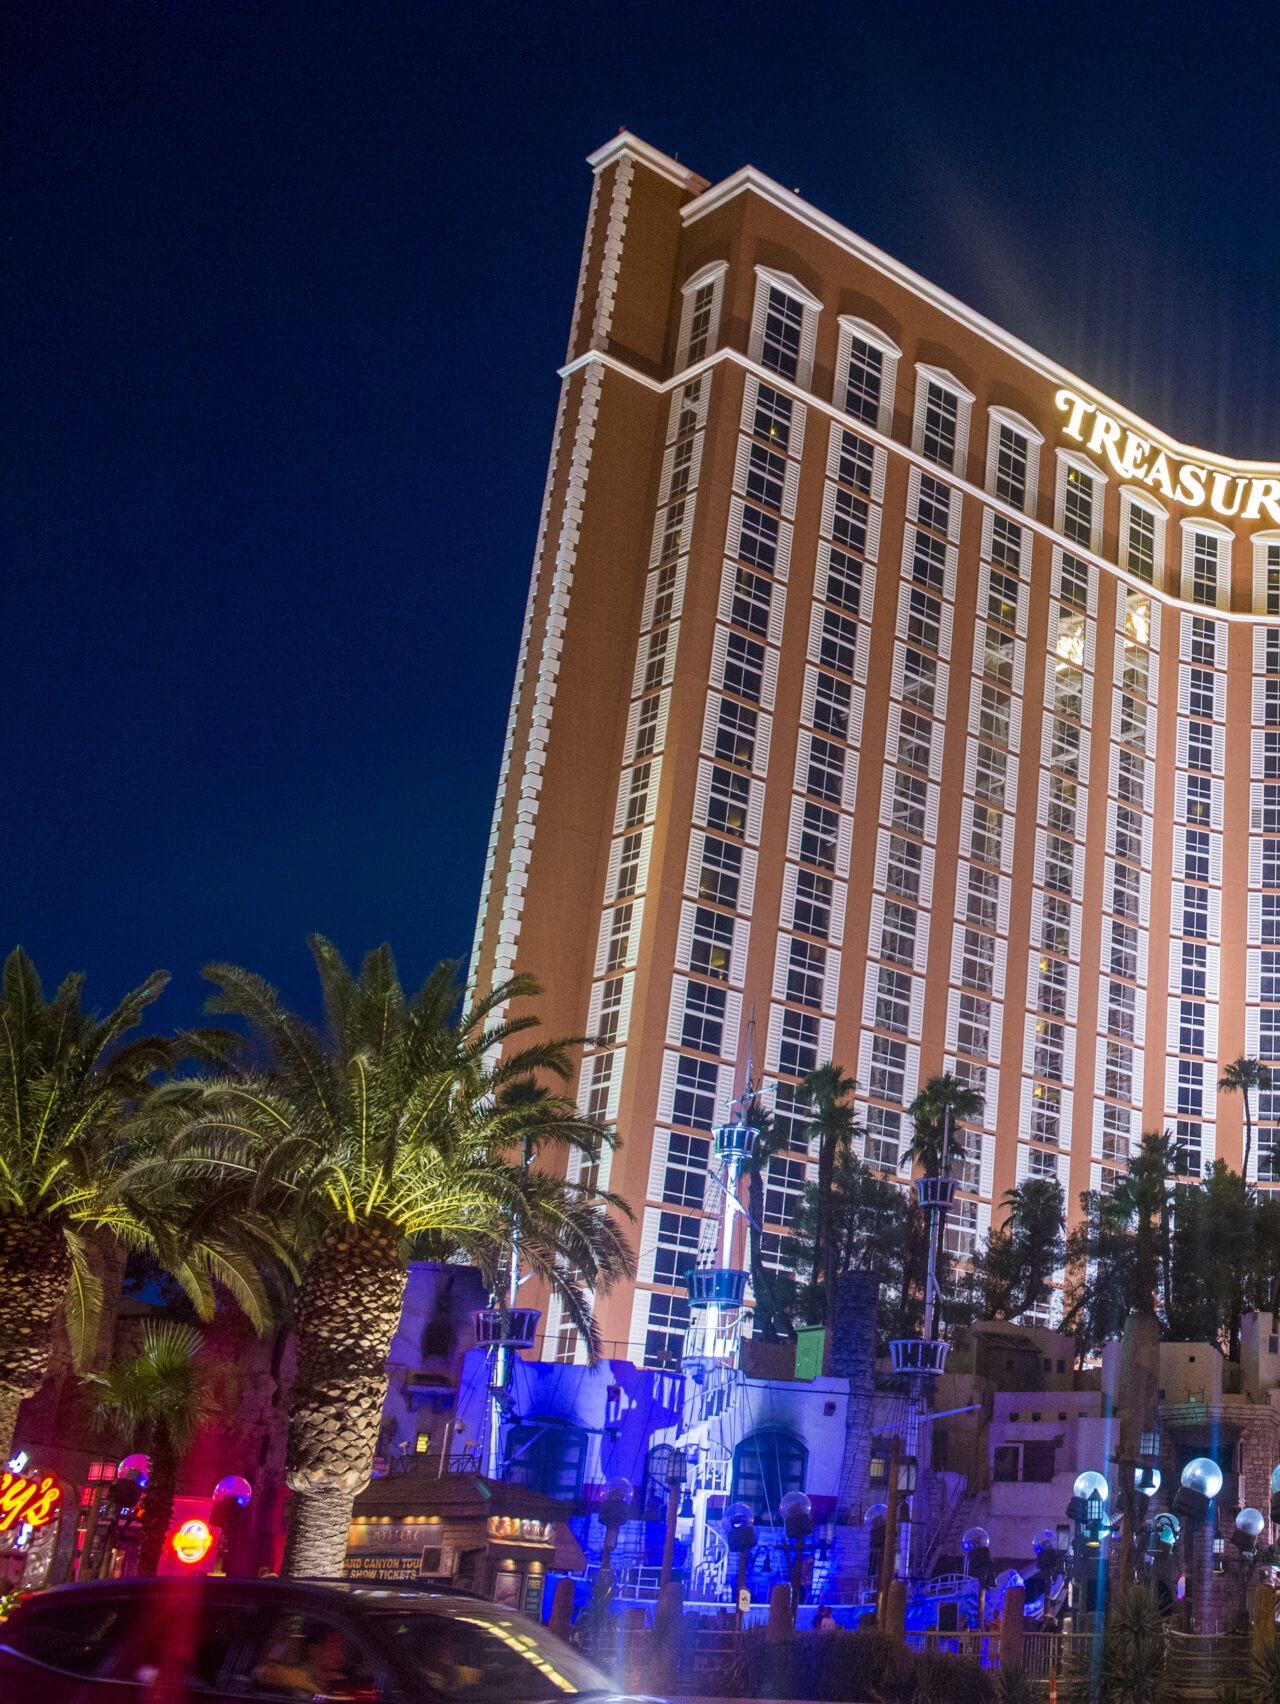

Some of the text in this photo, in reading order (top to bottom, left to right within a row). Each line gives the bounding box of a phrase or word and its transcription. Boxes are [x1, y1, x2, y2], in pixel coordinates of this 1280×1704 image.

[343, 1558, 362, 1569] AND
[363, 1558, 400, 1569] CANYON
[350, 1570, 377, 1579] SHOW
[378, 1569, 417, 1580] TICKETS
